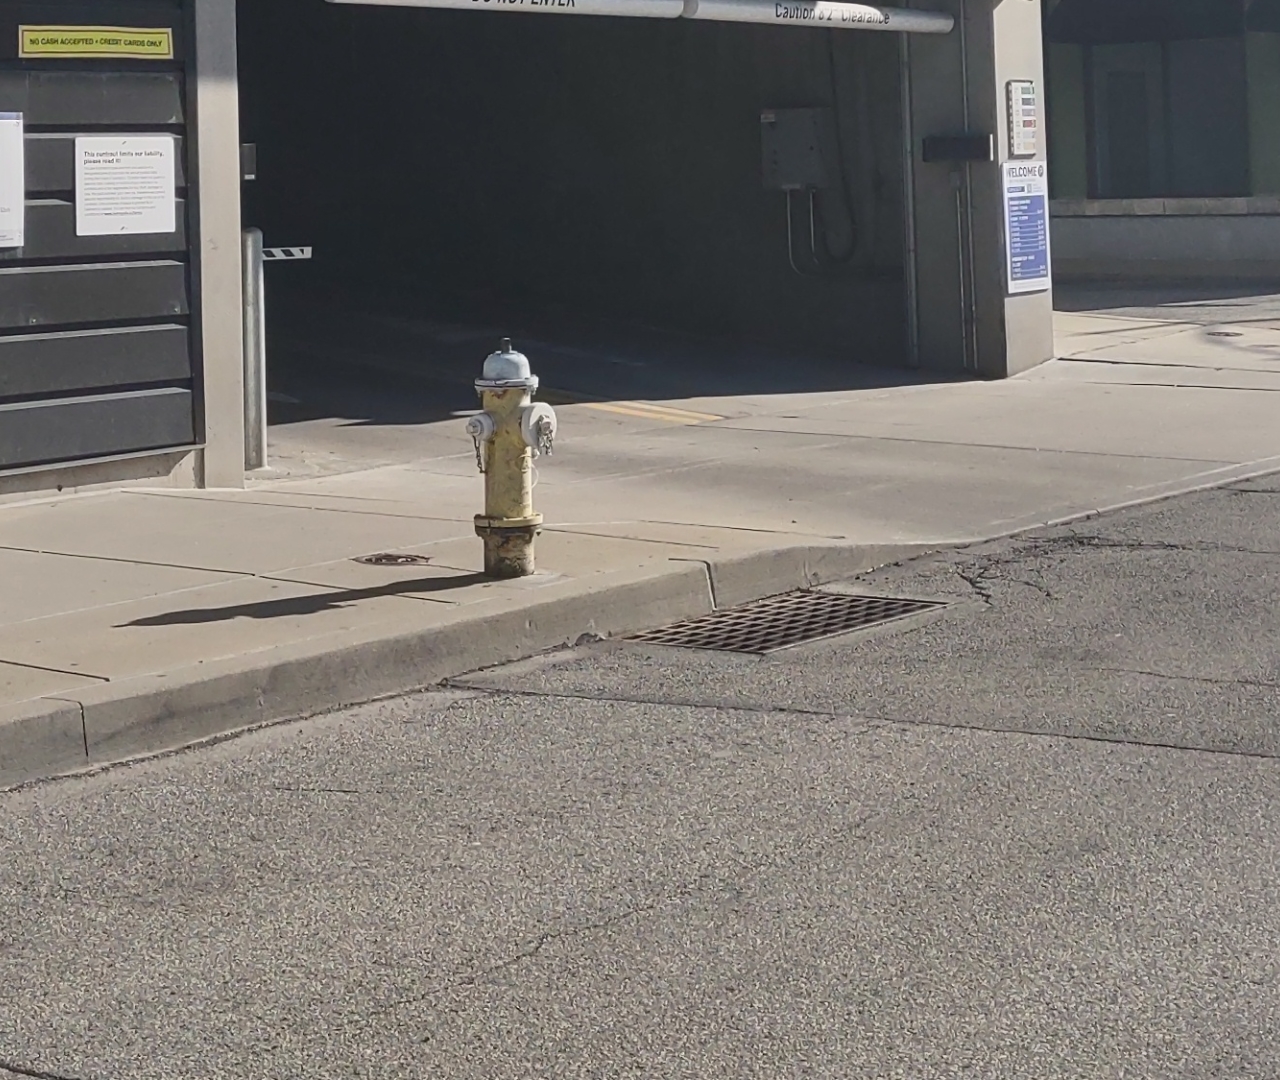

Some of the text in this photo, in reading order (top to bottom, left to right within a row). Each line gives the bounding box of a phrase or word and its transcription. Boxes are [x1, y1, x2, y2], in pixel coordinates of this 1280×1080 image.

[775, 3, 816, 20] Caution
[841, 8, 890, 25] Clearance
[29, 37, 163, 48] NO CASH ACCEPTED CREDIT CARDS ONLY
